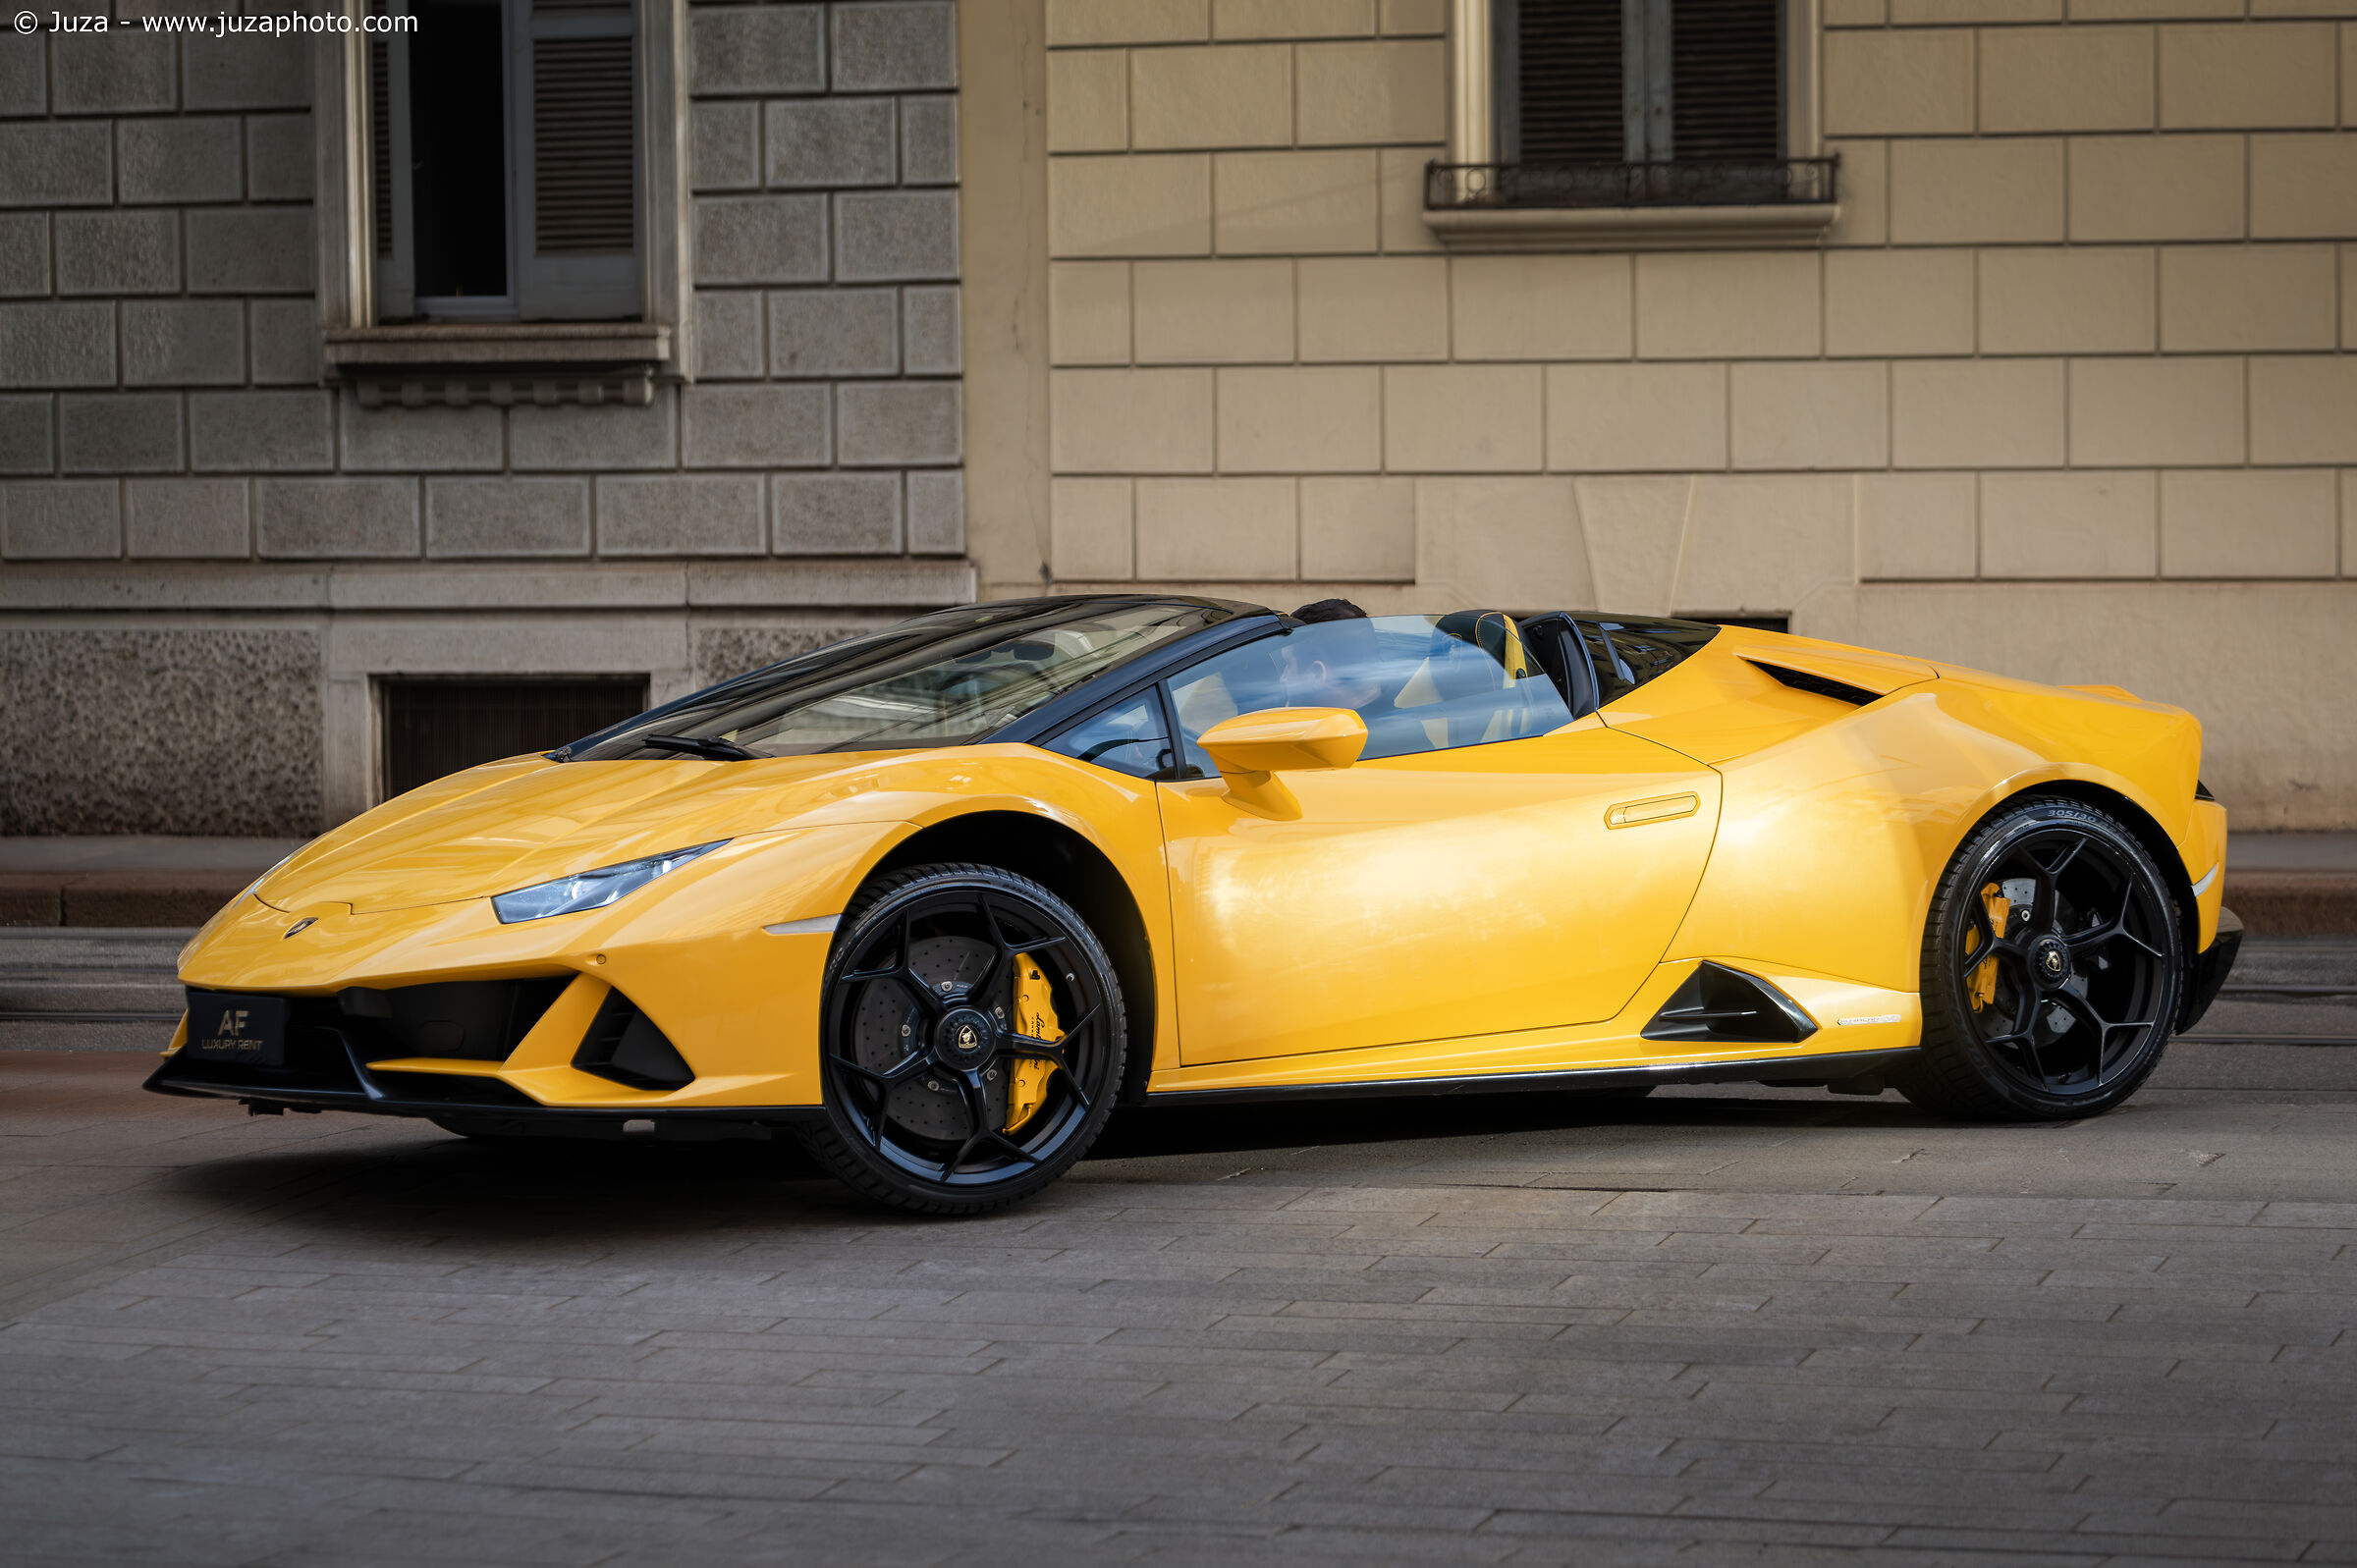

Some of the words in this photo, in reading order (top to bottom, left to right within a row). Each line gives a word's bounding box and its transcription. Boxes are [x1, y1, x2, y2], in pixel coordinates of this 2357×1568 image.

[2048, 809, 2096, 823] 305/30
[217, 1009, 249, 1036] AF
[201, 1039, 236, 1051] LUXURY
[238, 1040, 263, 1052] RENT
